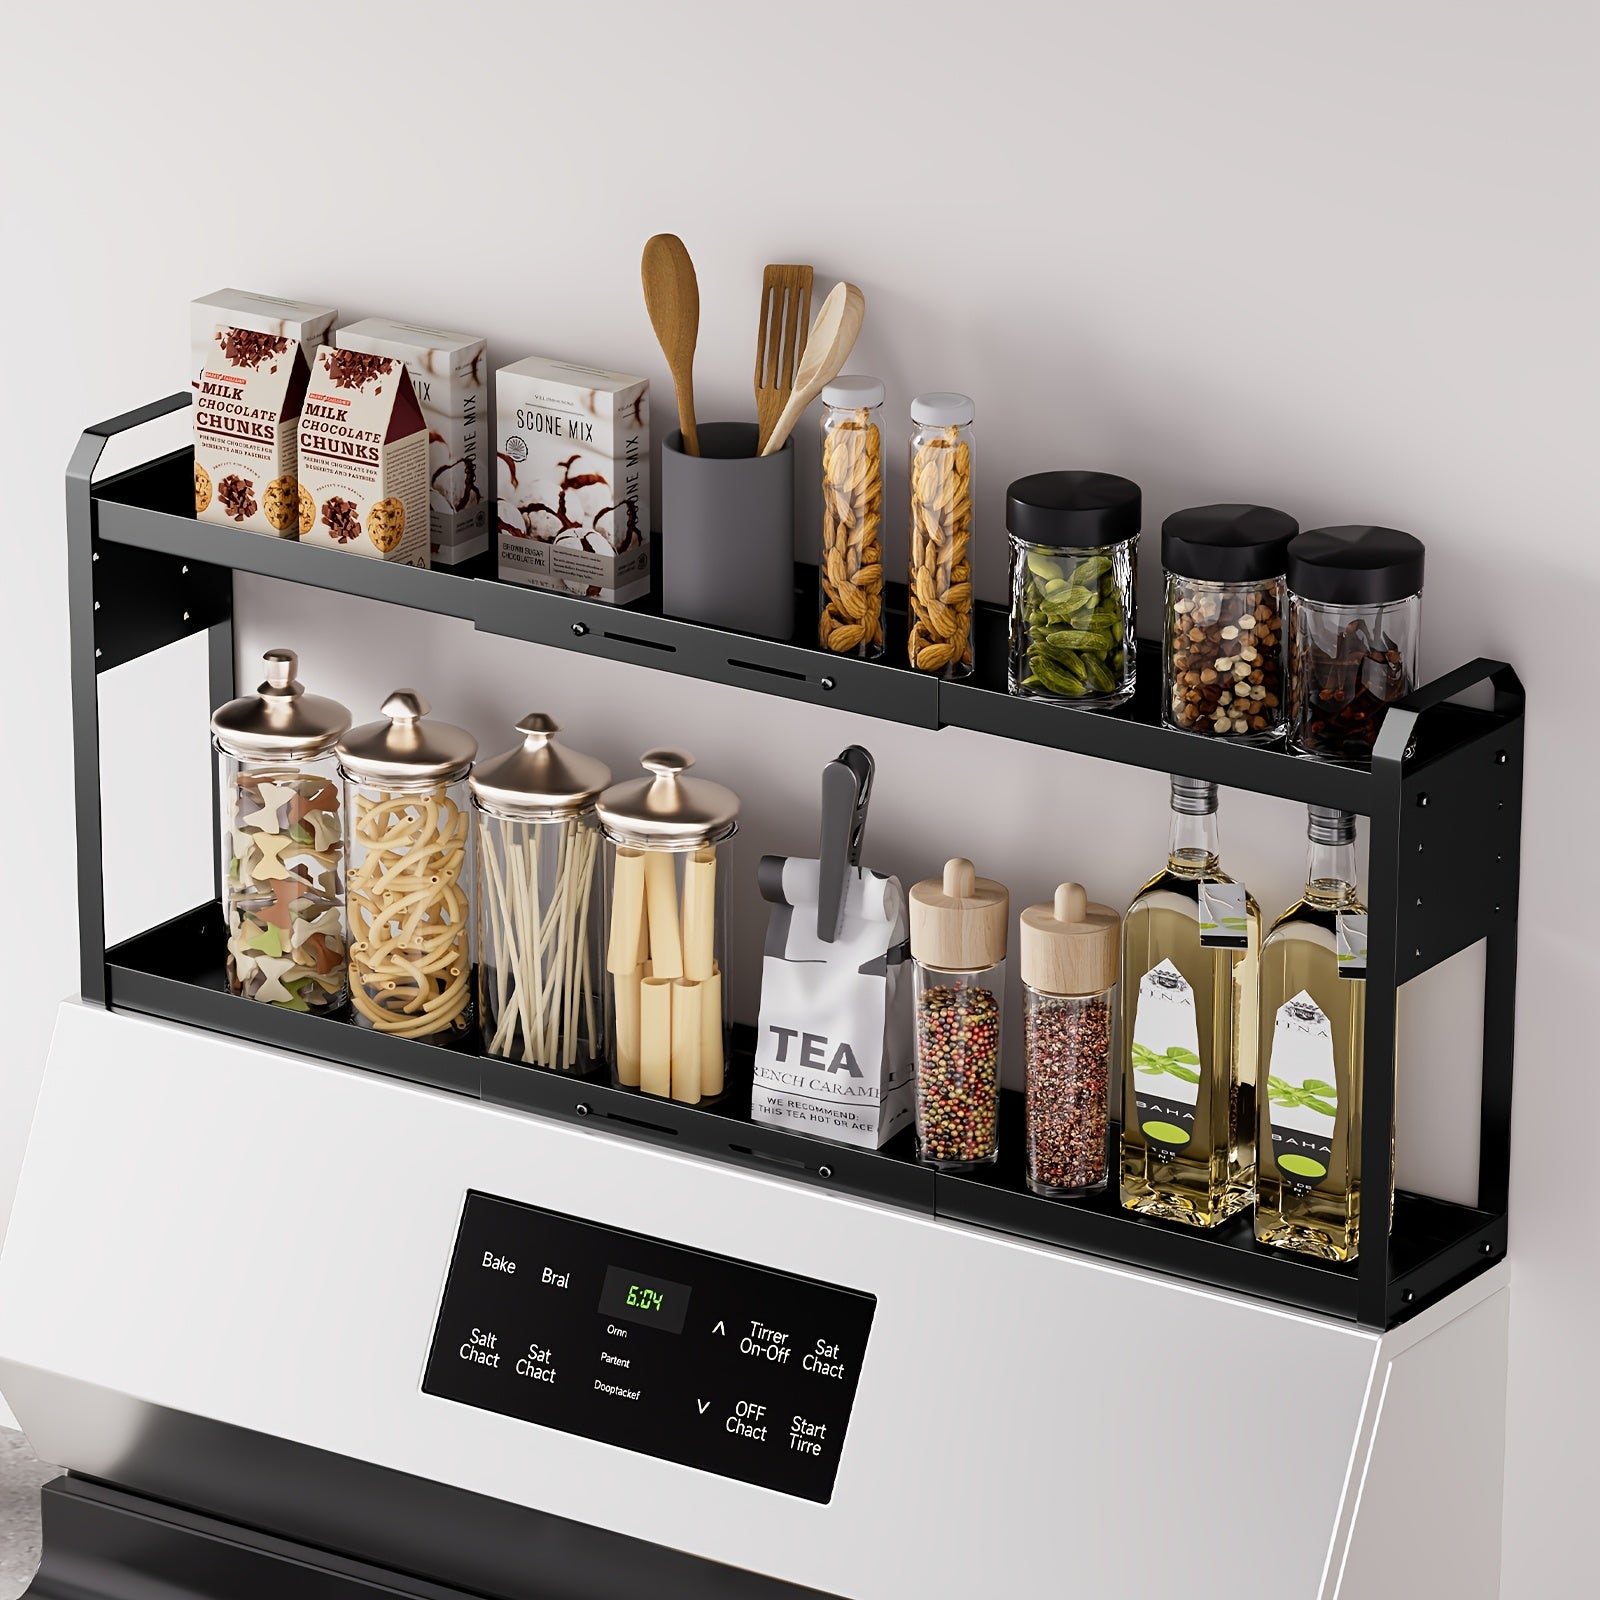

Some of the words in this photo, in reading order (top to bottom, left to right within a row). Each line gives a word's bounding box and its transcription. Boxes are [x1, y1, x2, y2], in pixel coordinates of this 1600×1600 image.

[202, 382, 244, 400] MILK
[198, 398, 276, 422] CHOCOLATE
[305, 403, 348, 422] MILK
[464, 395, 476, 426] MIX
[197, 412, 274, 439] CHUNKS
[302, 419, 381, 443] CHOCOLATE
[516, 409, 562, 436] SCONE
[569, 420, 593, 442] MIX
[227, 440, 260, 451] CHOCOLATE
[301, 433, 379, 460] CHUNKS
[626, 436, 638, 467] MIX
[306, 464, 333, 474] DESSERTS
[331, 460, 364, 472] CHOCOLATE
[502, 552, 534, 564] CHOCOLATE
[525, 547, 544, 557] SUGAR
[770, 1025, 864, 1078] TEA
[758, 1104, 782, 1115] THIS
[786, 1109, 806, 1120] TEA
[810, 1114, 831, 1124] HOT
[834, 1119, 848, 1128] OR
[767, 1097, 784, 1106] WE
[788, 1100, 859, 1121] RECOMMEND:
[1272, 1134, 1331, 1153] BAHA
[482, 1251, 516, 1274] Bake
[541, 1267, 570, 1289] Bral
[626, 1285, 663, 1311] 6:04
[470, 1328, 498, 1350] Salt
[751, 1320, 789, 1345] Tirrer
[459, 1343, 500, 1368] Chact
[528, 1343, 552, 1365] Sat
[740, 1337, 791, 1364] On-Off
[815, 1339, 839, 1360] Sat
[515, 1358, 556, 1384] Chact
[802, 1354, 844, 1379] Chact
[735, 1400, 767, 1421] OFF
[726, 1416, 767, 1442] Chact
[791, 1416, 826, 1439] Start
[789, 1432, 822, 1456] Tirre
